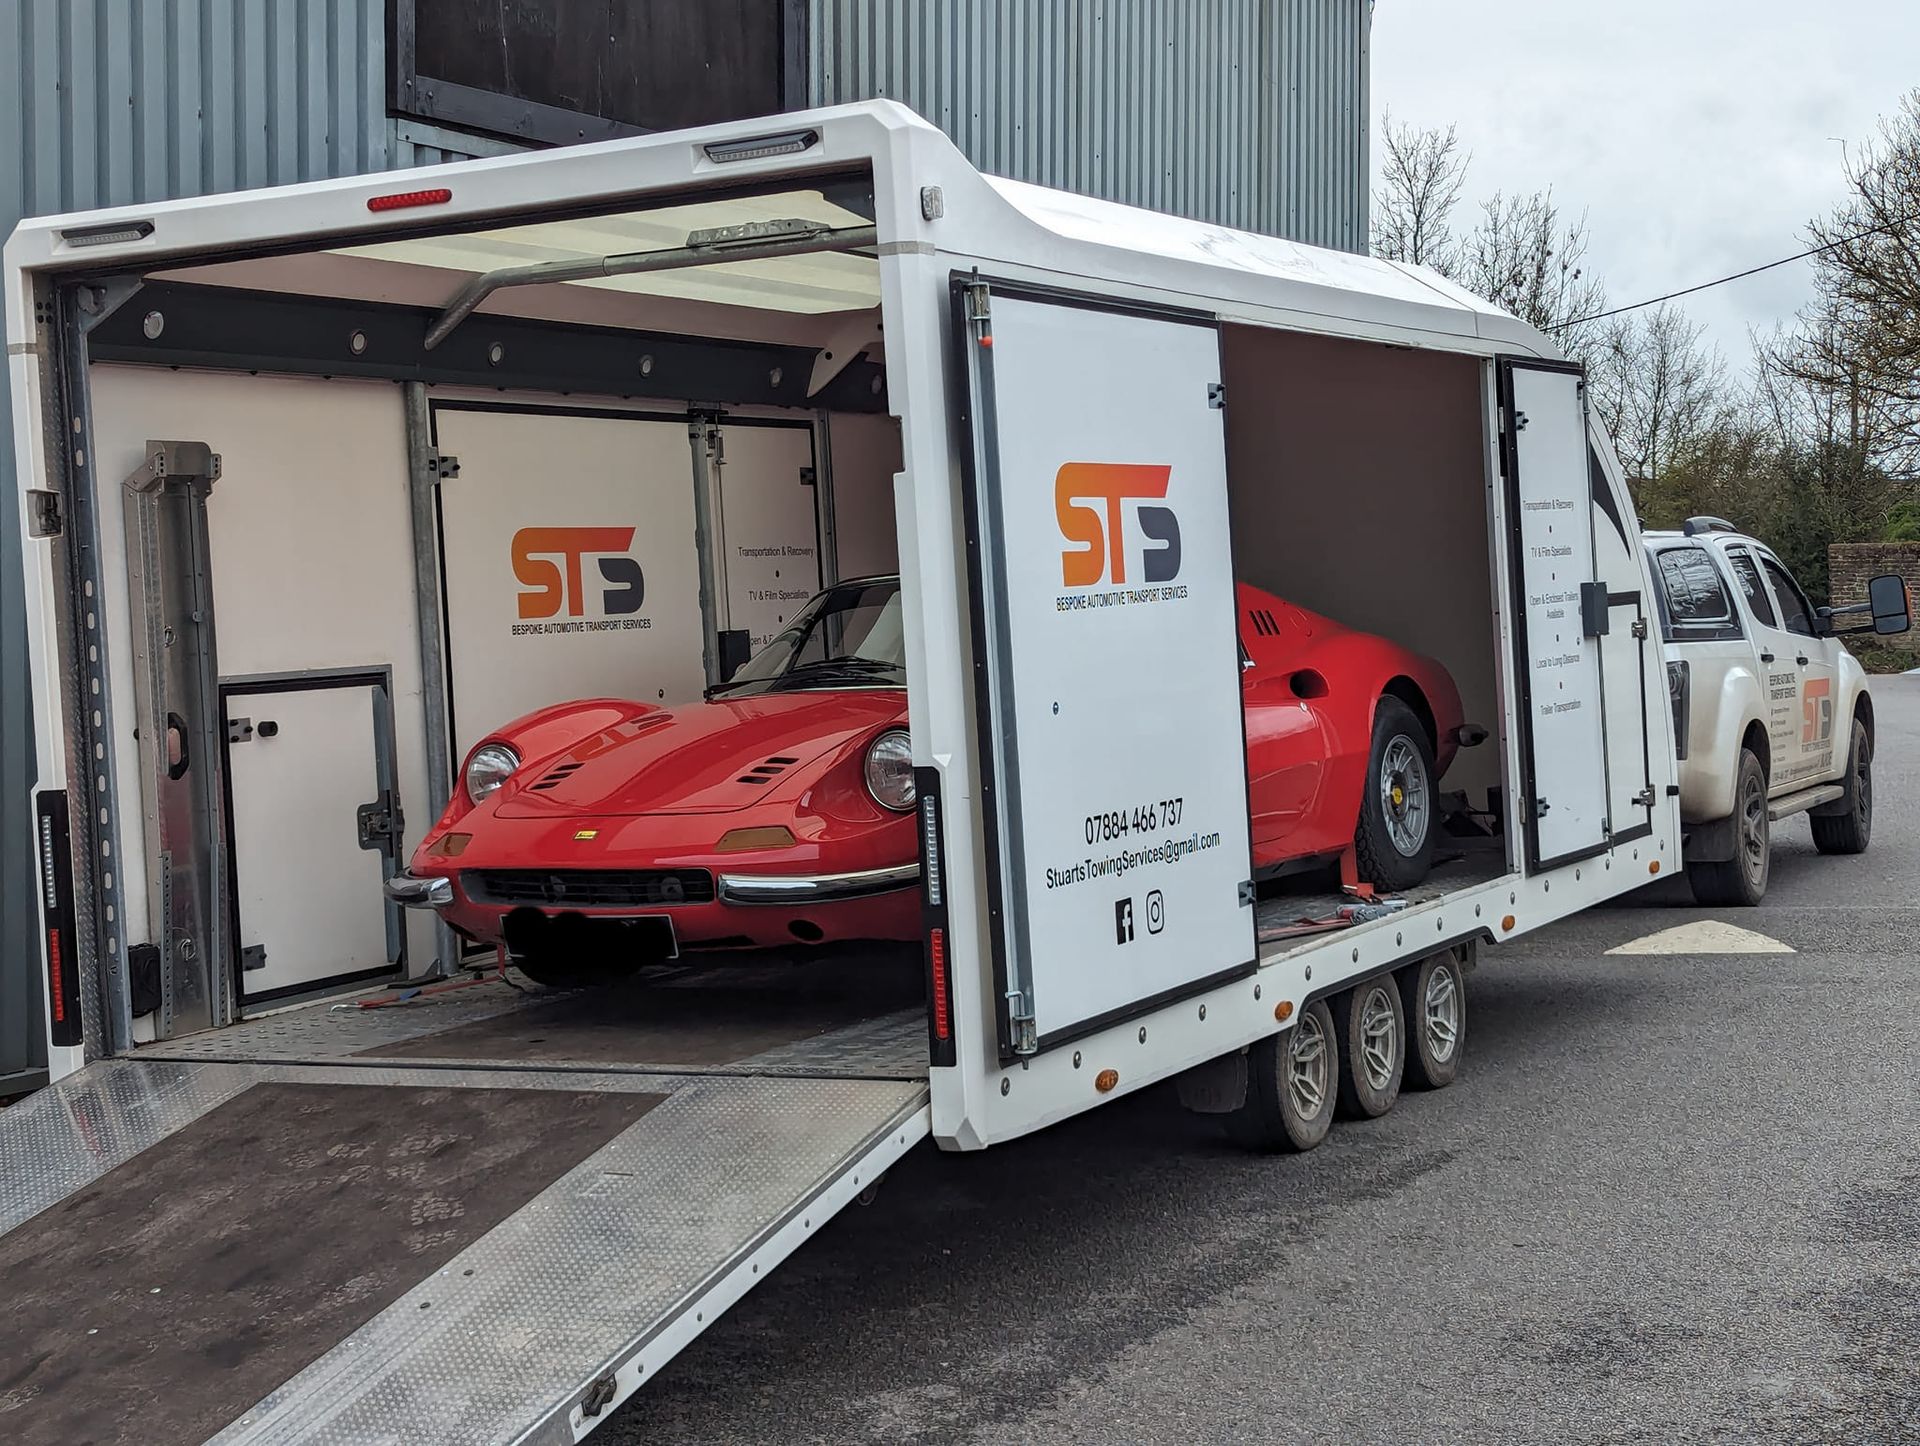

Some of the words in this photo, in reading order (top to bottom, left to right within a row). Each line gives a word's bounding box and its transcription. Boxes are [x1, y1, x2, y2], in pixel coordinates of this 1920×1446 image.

[1055, 462, 1181, 587] STS
[738, 546, 780, 558] Transportation
[782, 546, 786, 556] &
[787, 546, 814, 558] Recovery
[511, 527, 644, 619] STS
[749, 590, 758, 600] TV
[760, 590, 764, 600] &
[765, 590, 778, 600] Film
[779, 590, 809, 602] Specialists
[1056, 595, 1086, 611] BESPOKE
[1087, 591, 1125, 607] AUTOMOTIVE
[1126, 588, 1160, 603] TRANSPORT
[1161, 585, 1188, 600] SERVICES
[512, 623, 543, 635] BESPOKE
[544, 621, 584, 634] AUTOMOTIVE
[585, 620, 622, 632] TRANSPORT
[622, 618, 651, 630] SERVICES
[1085, 809, 1129, 845] 07884
[1132, 803, 1157, 834] 466
[1159, 797, 1183, 828] 737
[1046, 832, 1221, 889] StuartsTowingServices@gmail.com
